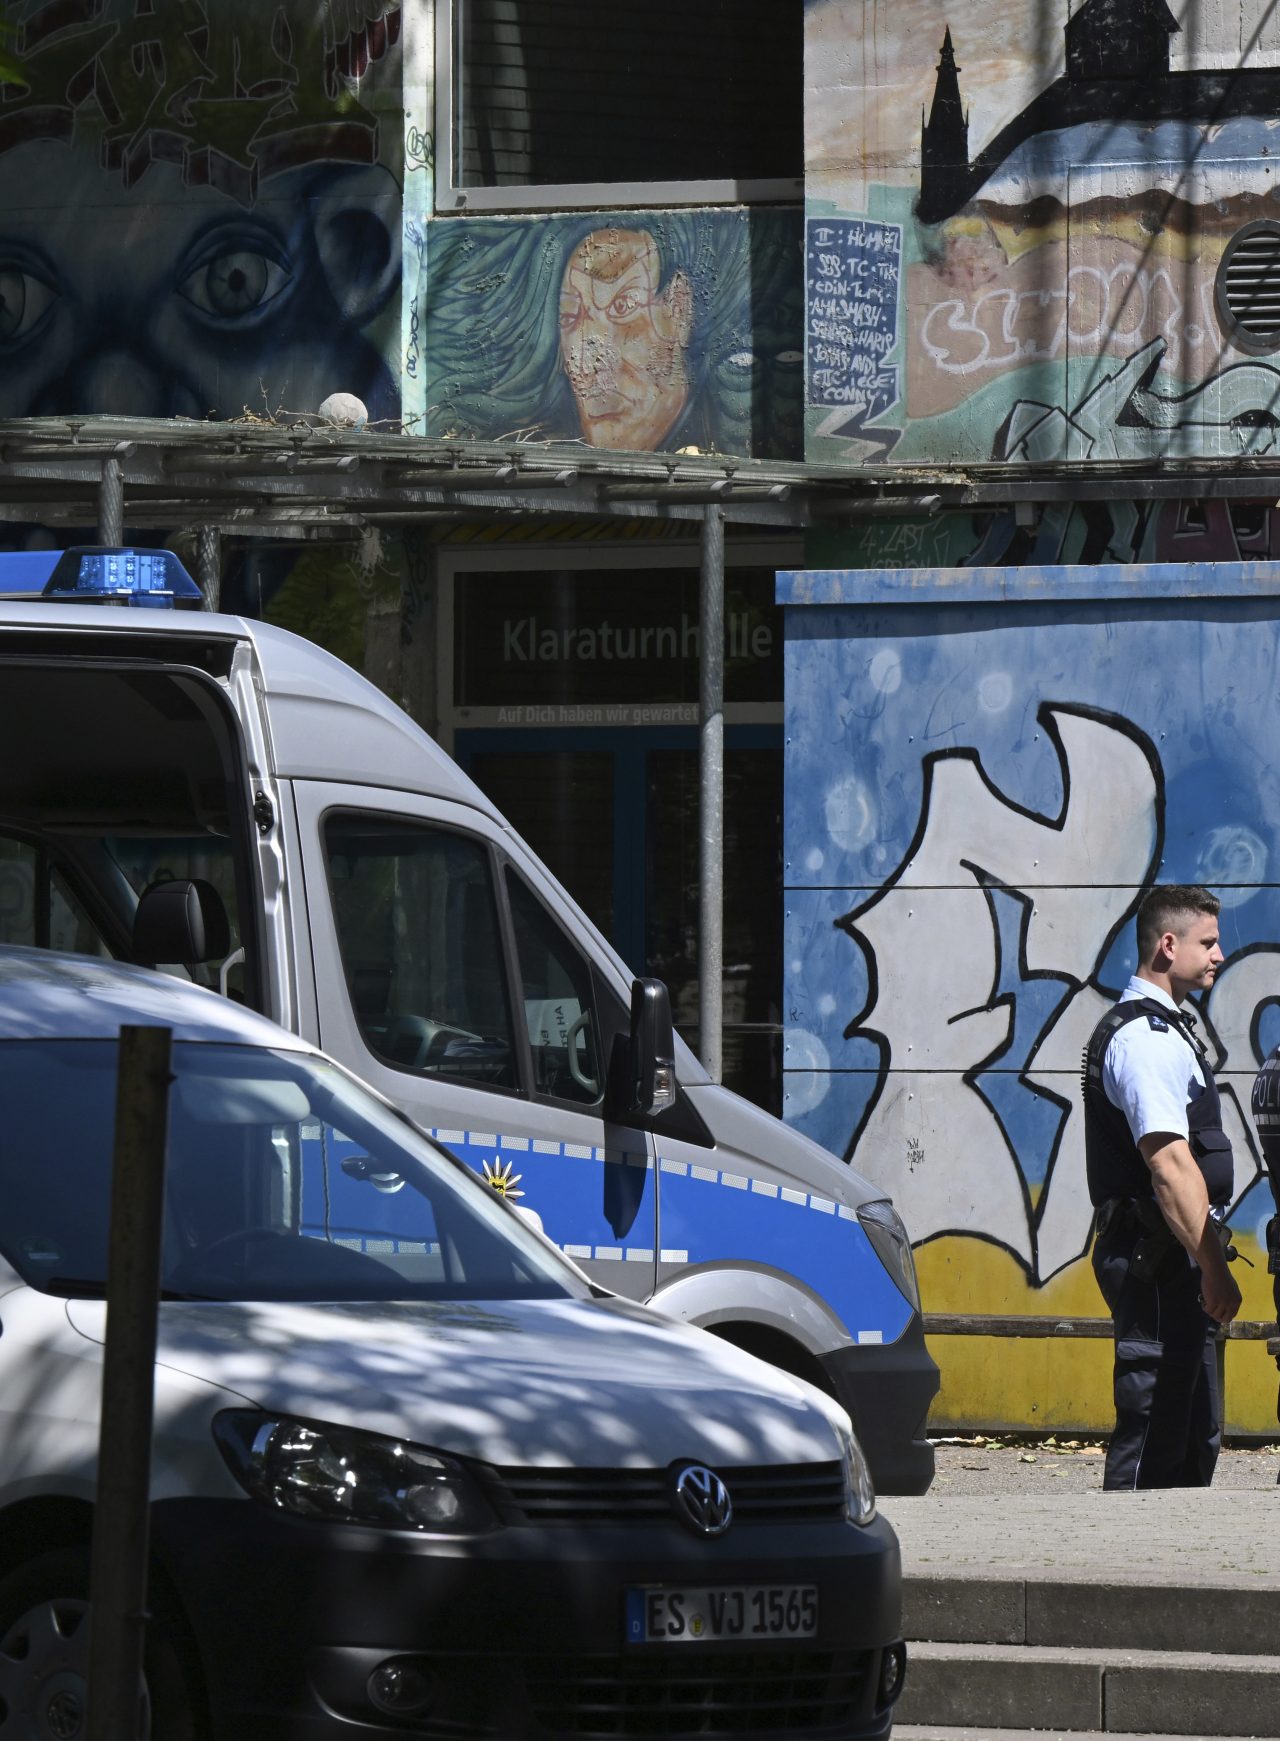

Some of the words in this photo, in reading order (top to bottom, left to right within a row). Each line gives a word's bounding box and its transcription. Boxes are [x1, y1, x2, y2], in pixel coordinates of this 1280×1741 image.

[503, 612, 774, 662] Klaraturnhlle
[497, 706, 522, 724] Auf
[526, 705, 556, 723] Dich
[559, 705, 603, 723] haben
[605, 703, 630, 722] wir
[632, 703, 700, 726] gewartet
[632, 1620, 641, 1633] D
[647, 1592, 686, 1637] ES
[708, 1591, 745, 1635] VJ
[752, 1588, 816, 1633] 1565
